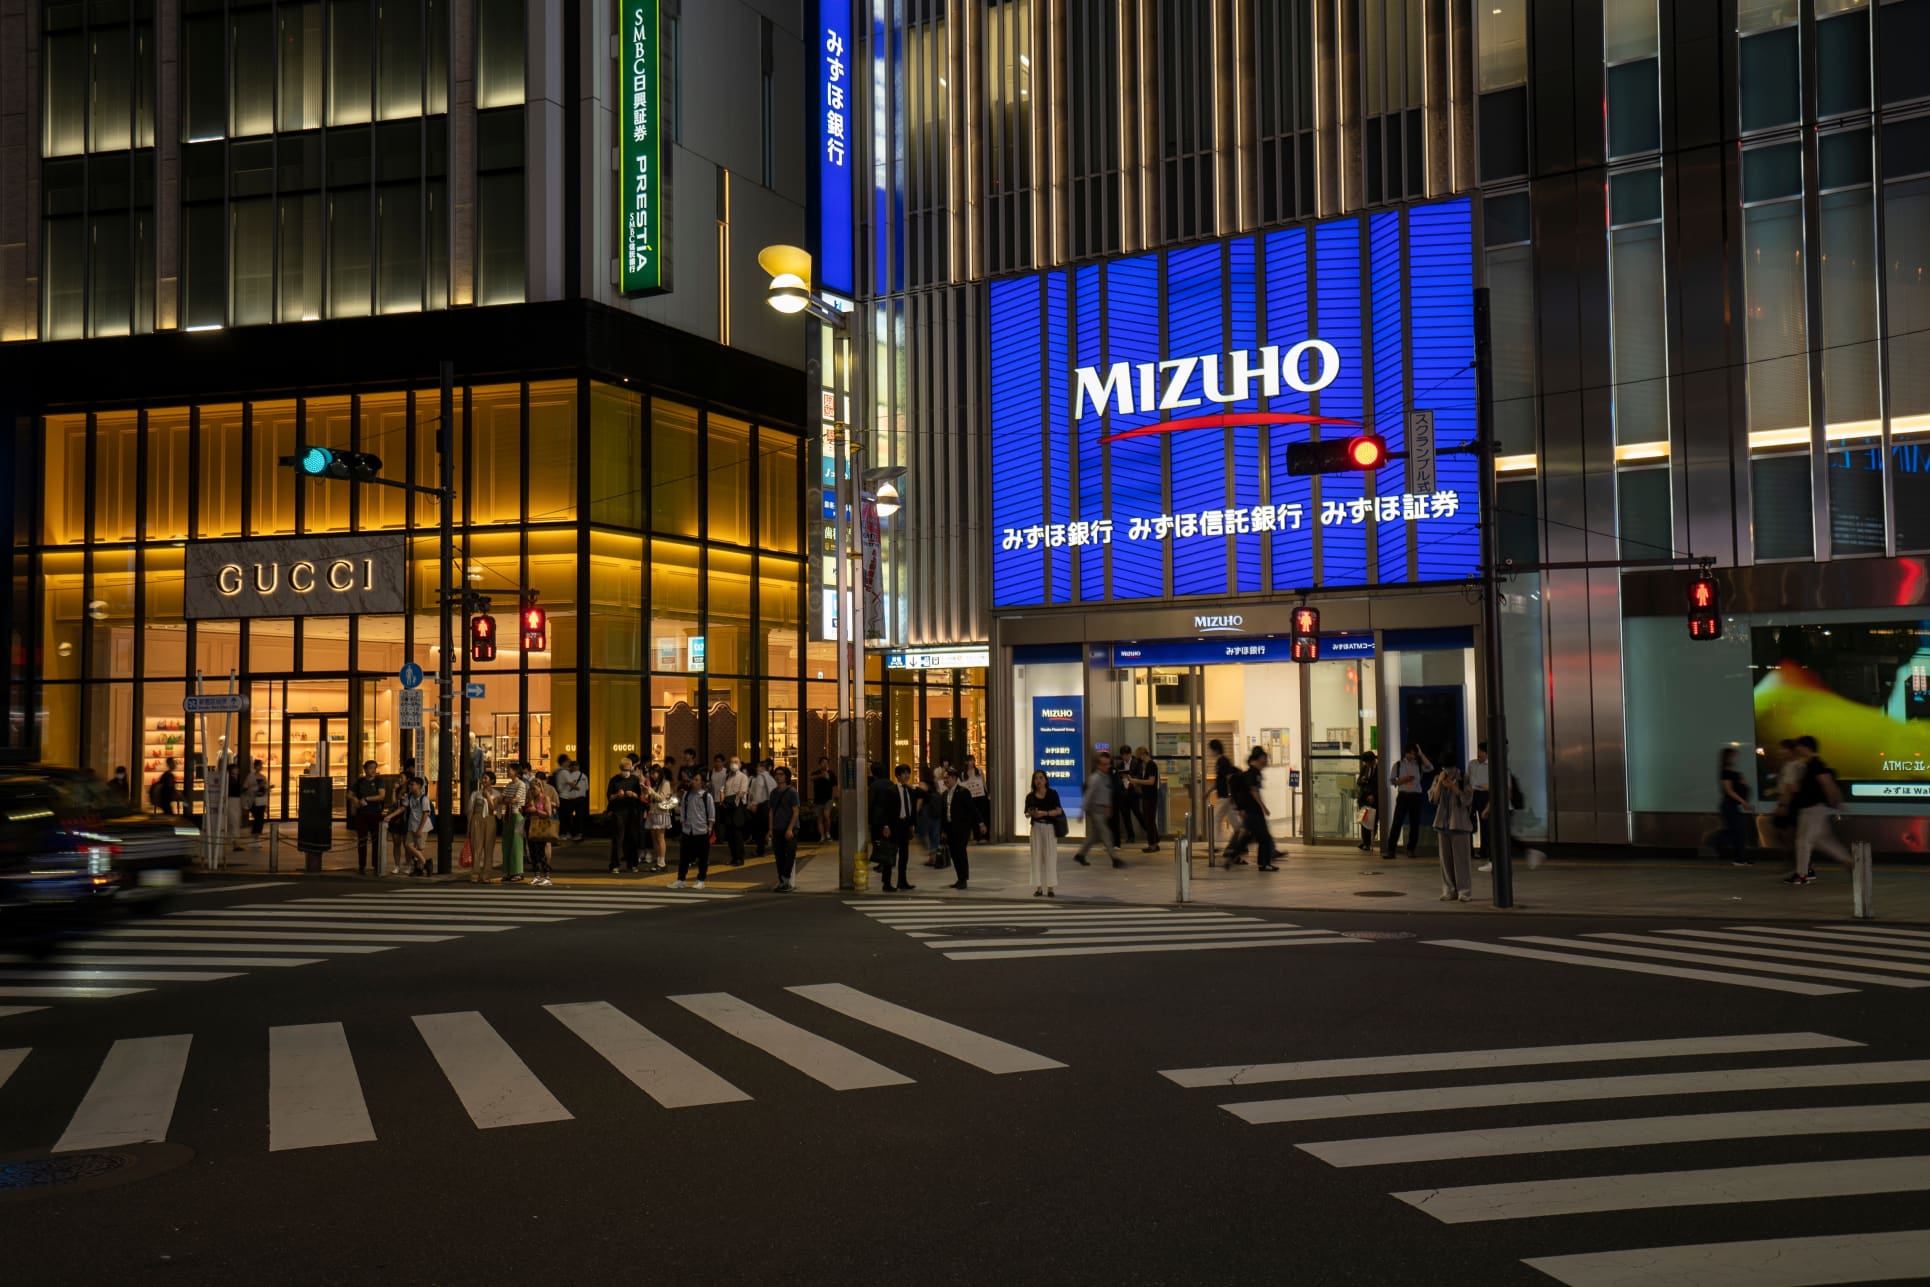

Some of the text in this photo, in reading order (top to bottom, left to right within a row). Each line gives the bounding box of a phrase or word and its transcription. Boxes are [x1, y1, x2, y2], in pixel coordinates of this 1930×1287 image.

[633, 8, 647, 142] SMBC日興証券
[826, 29, 845, 167] みずほ銀行
[1074, 338, 1341, 420] MIZUHO
[1415, 413, 1432, 493] スクランブル式
[1002, 491, 1460, 550] みずほ銀行 みずほ信託銀行 みずほ証券
[216, 558, 373, 595] GUCCI
[1194, 615, 1243, 628] MIZUHO
[1225, 646, 1265, 656] みずほ銀行
[1332, 643, 1375, 651] みずほATMコー
[1042, 709, 1073, 718] MIZUHO
[612, 743, 635, 752] GUCCI
[1883, 786, 1911, 795] みずほ
